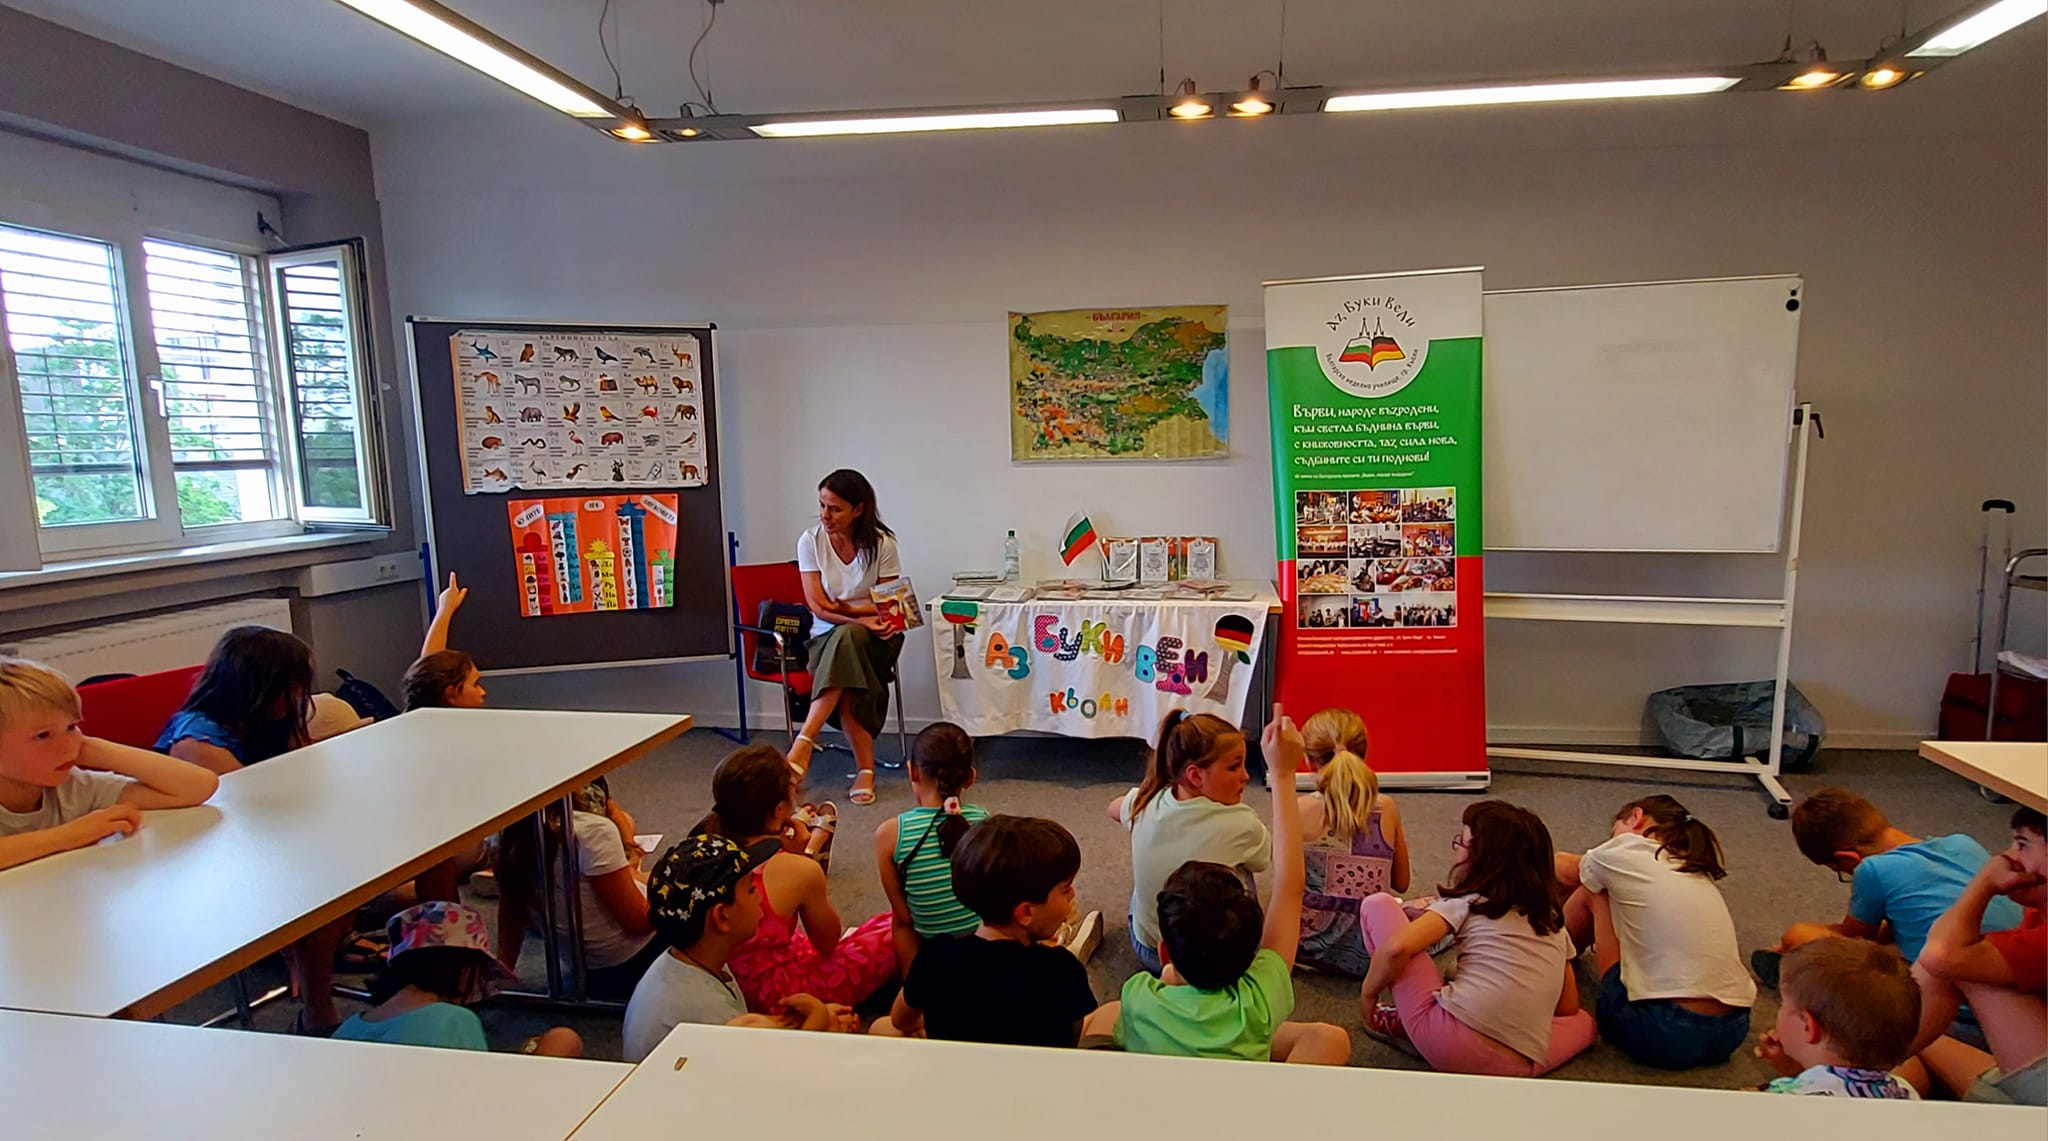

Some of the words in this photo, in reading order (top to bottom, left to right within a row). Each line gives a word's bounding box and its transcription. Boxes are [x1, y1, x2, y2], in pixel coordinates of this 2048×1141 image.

[1344, 297, 1381, 313] Буки
[1385, 296, 1416, 327] Веди
[1293, 404, 1337, 420] Върви,
[1338, 408, 1377, 418] народе
[1317, 424, 1353, 433] светла
[1355, 423, 1403, 434] бъднина
[1294, 441, 1300, 449] с
[1399, 438, 1426, 446] сила
[1294, 456, 1351, 467] съдбините
[1352, 455, 1365, 463] си
[1367, 455, 1380, 463] ти
[1034, 614, 1125, 664] БУКИ
